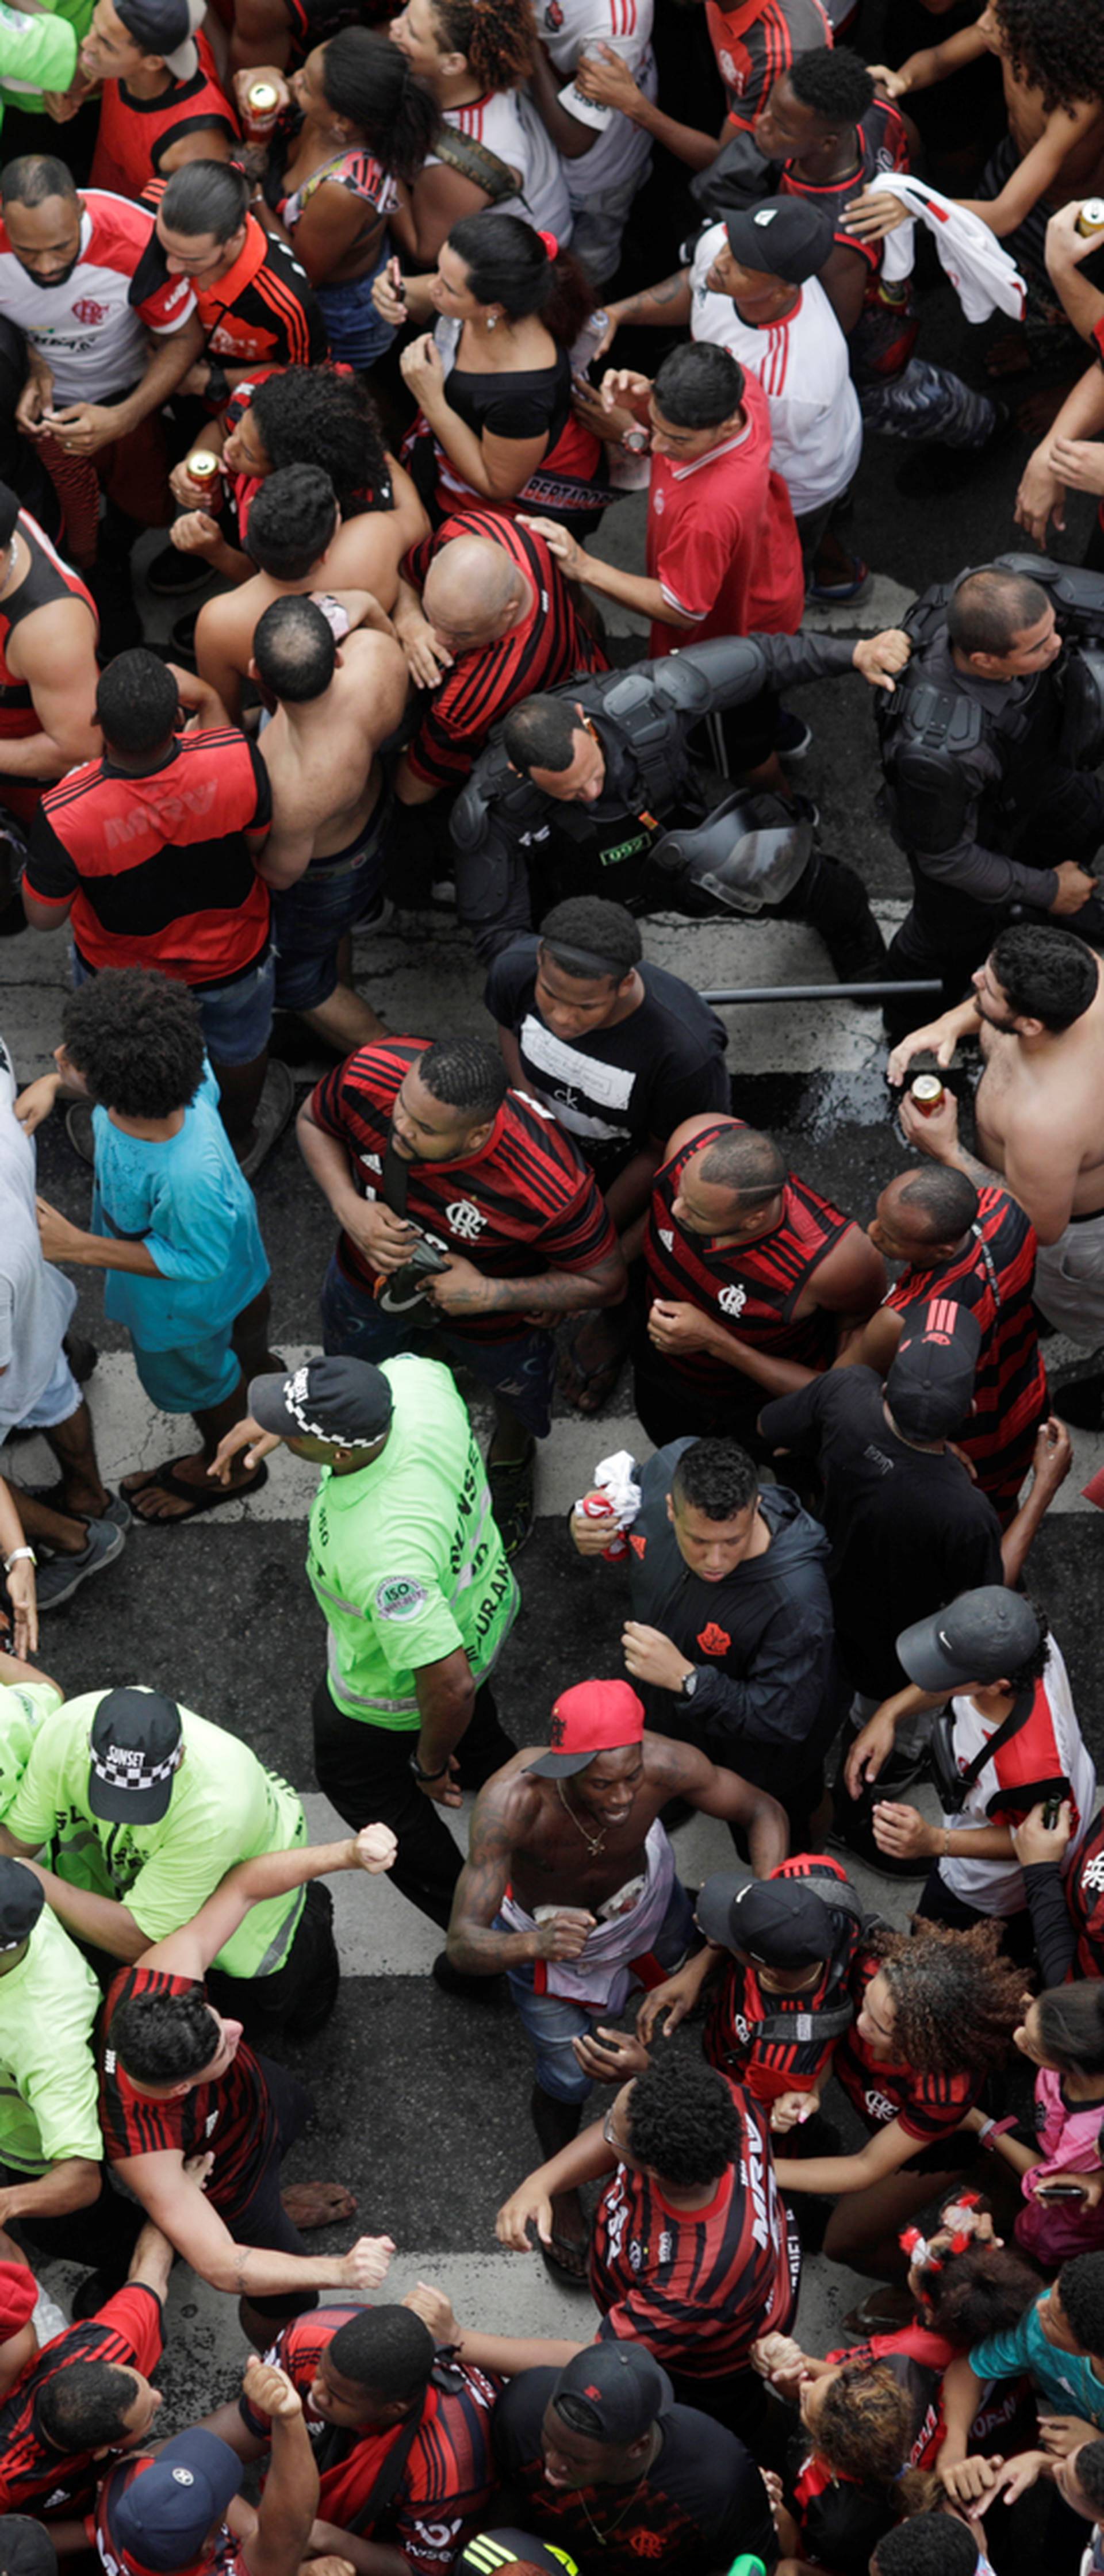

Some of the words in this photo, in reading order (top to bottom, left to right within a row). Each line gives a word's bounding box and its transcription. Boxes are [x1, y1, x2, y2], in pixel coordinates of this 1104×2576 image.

[610, 837, 643, 862] 092
[554, 1087, 578, 1109] ck
[385, 1585, 409, 1601] ISO
[107, 1745, 145, 1767] SUNSET
[745, 2113, 770, 2250] MRV
